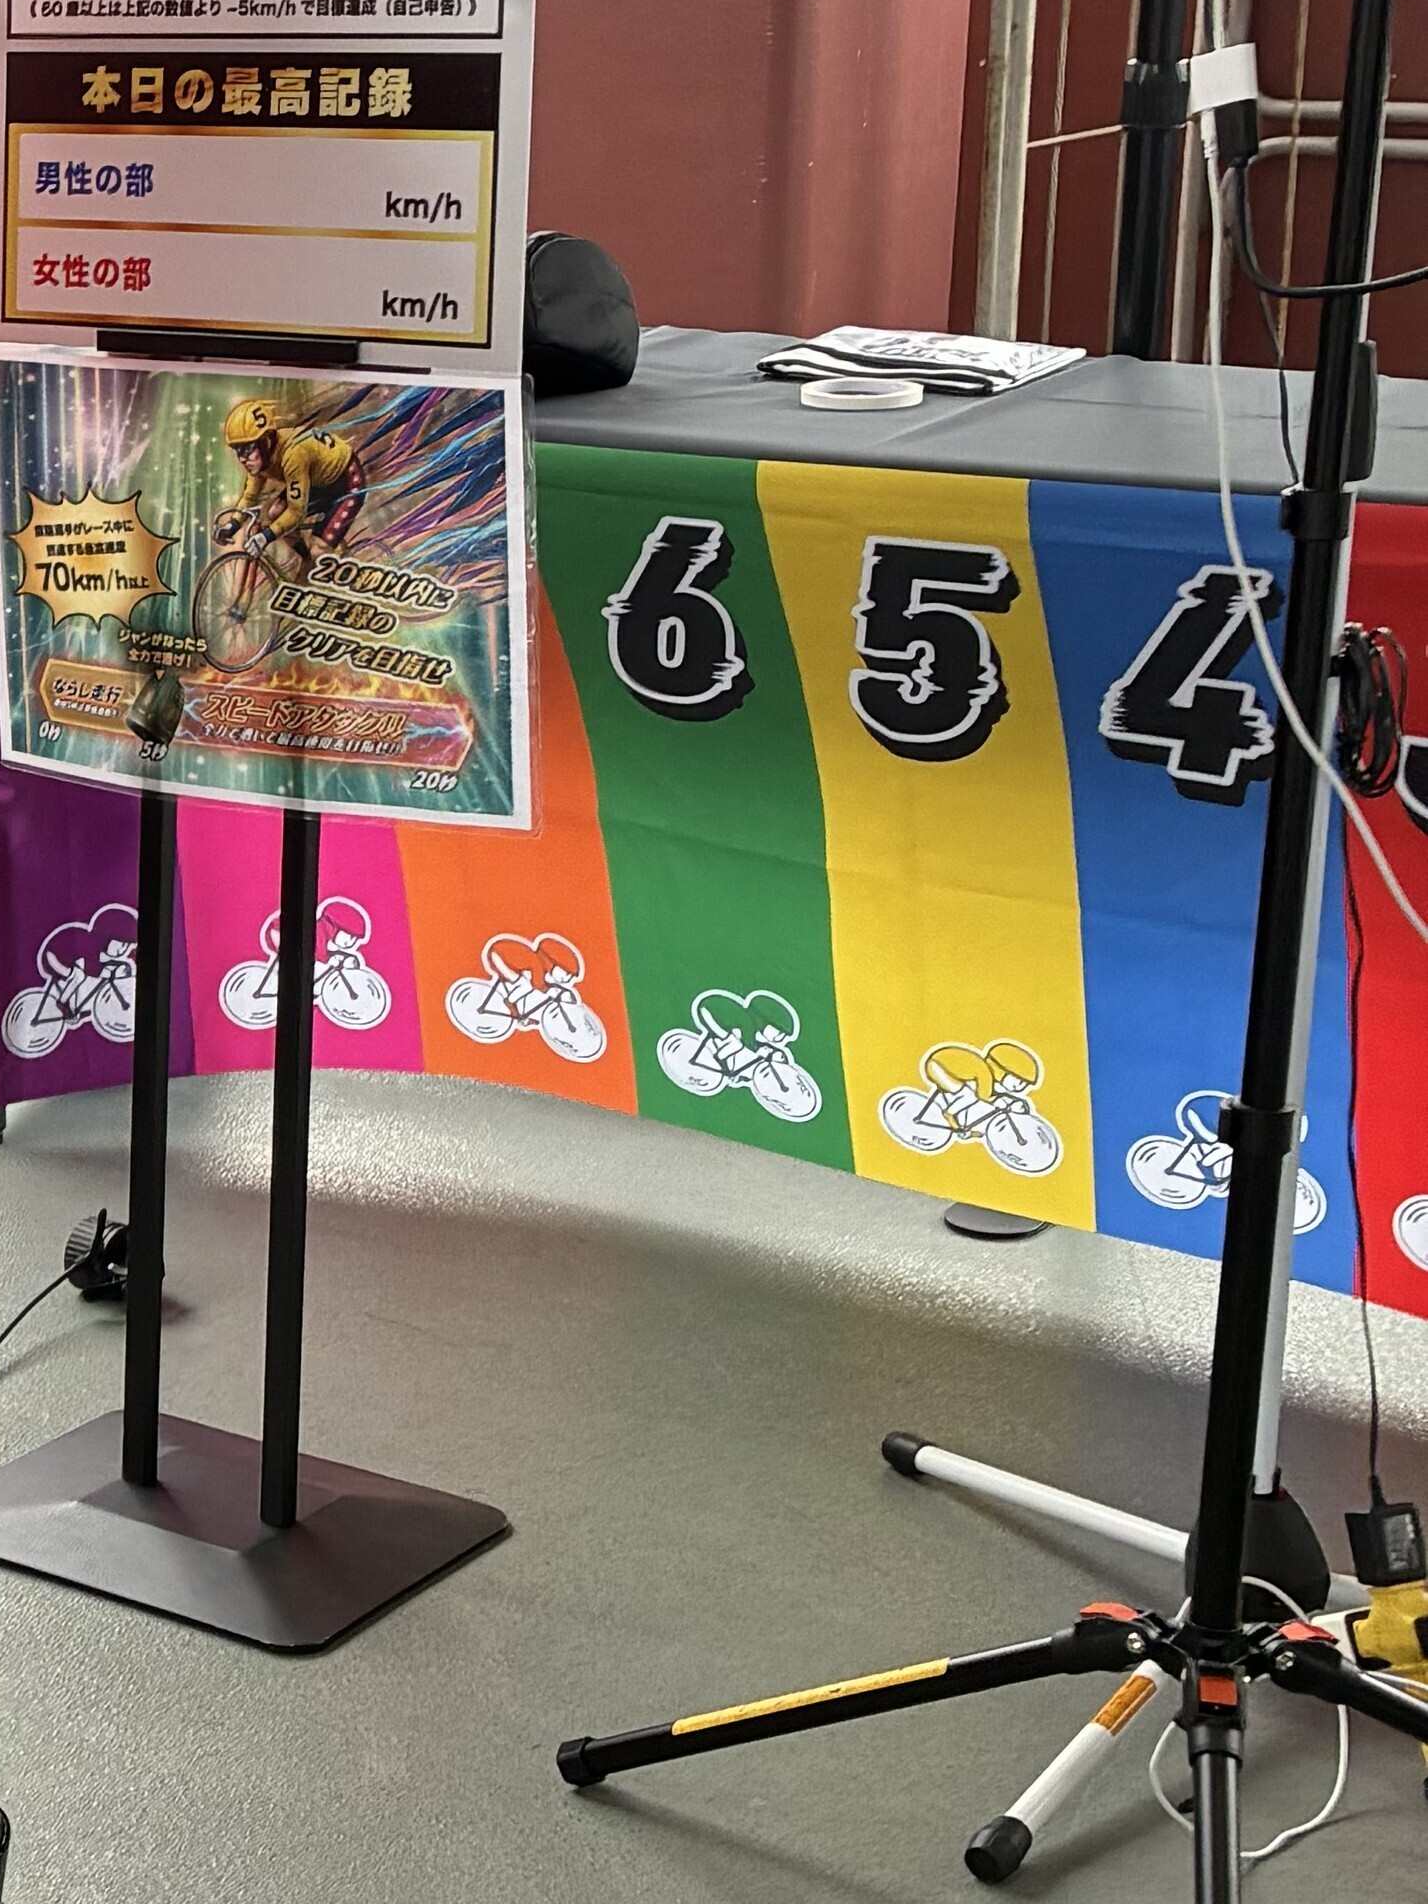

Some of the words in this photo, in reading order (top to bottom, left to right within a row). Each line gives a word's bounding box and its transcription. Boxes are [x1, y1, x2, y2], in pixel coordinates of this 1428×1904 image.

[81, 66, 413, 117] 本日の最高記録
[34, 161, 154, 197] 男性の部
[385, 191, 463, 221] km/h
[33, 256, 152, 291] 女性の部
[381, 290, 459, 321] km/h
[251, 406, 267, 429] 5
[289, 480, 302, 501] 5
[271, 587, 398, 635] 目標記録の
[601, 516, 752, 720] 6
[286, 628, 452, 686] クリアを目指せ
[849, 536, 1020, 761] 5
[1099, 564, 1283, 806] 4
